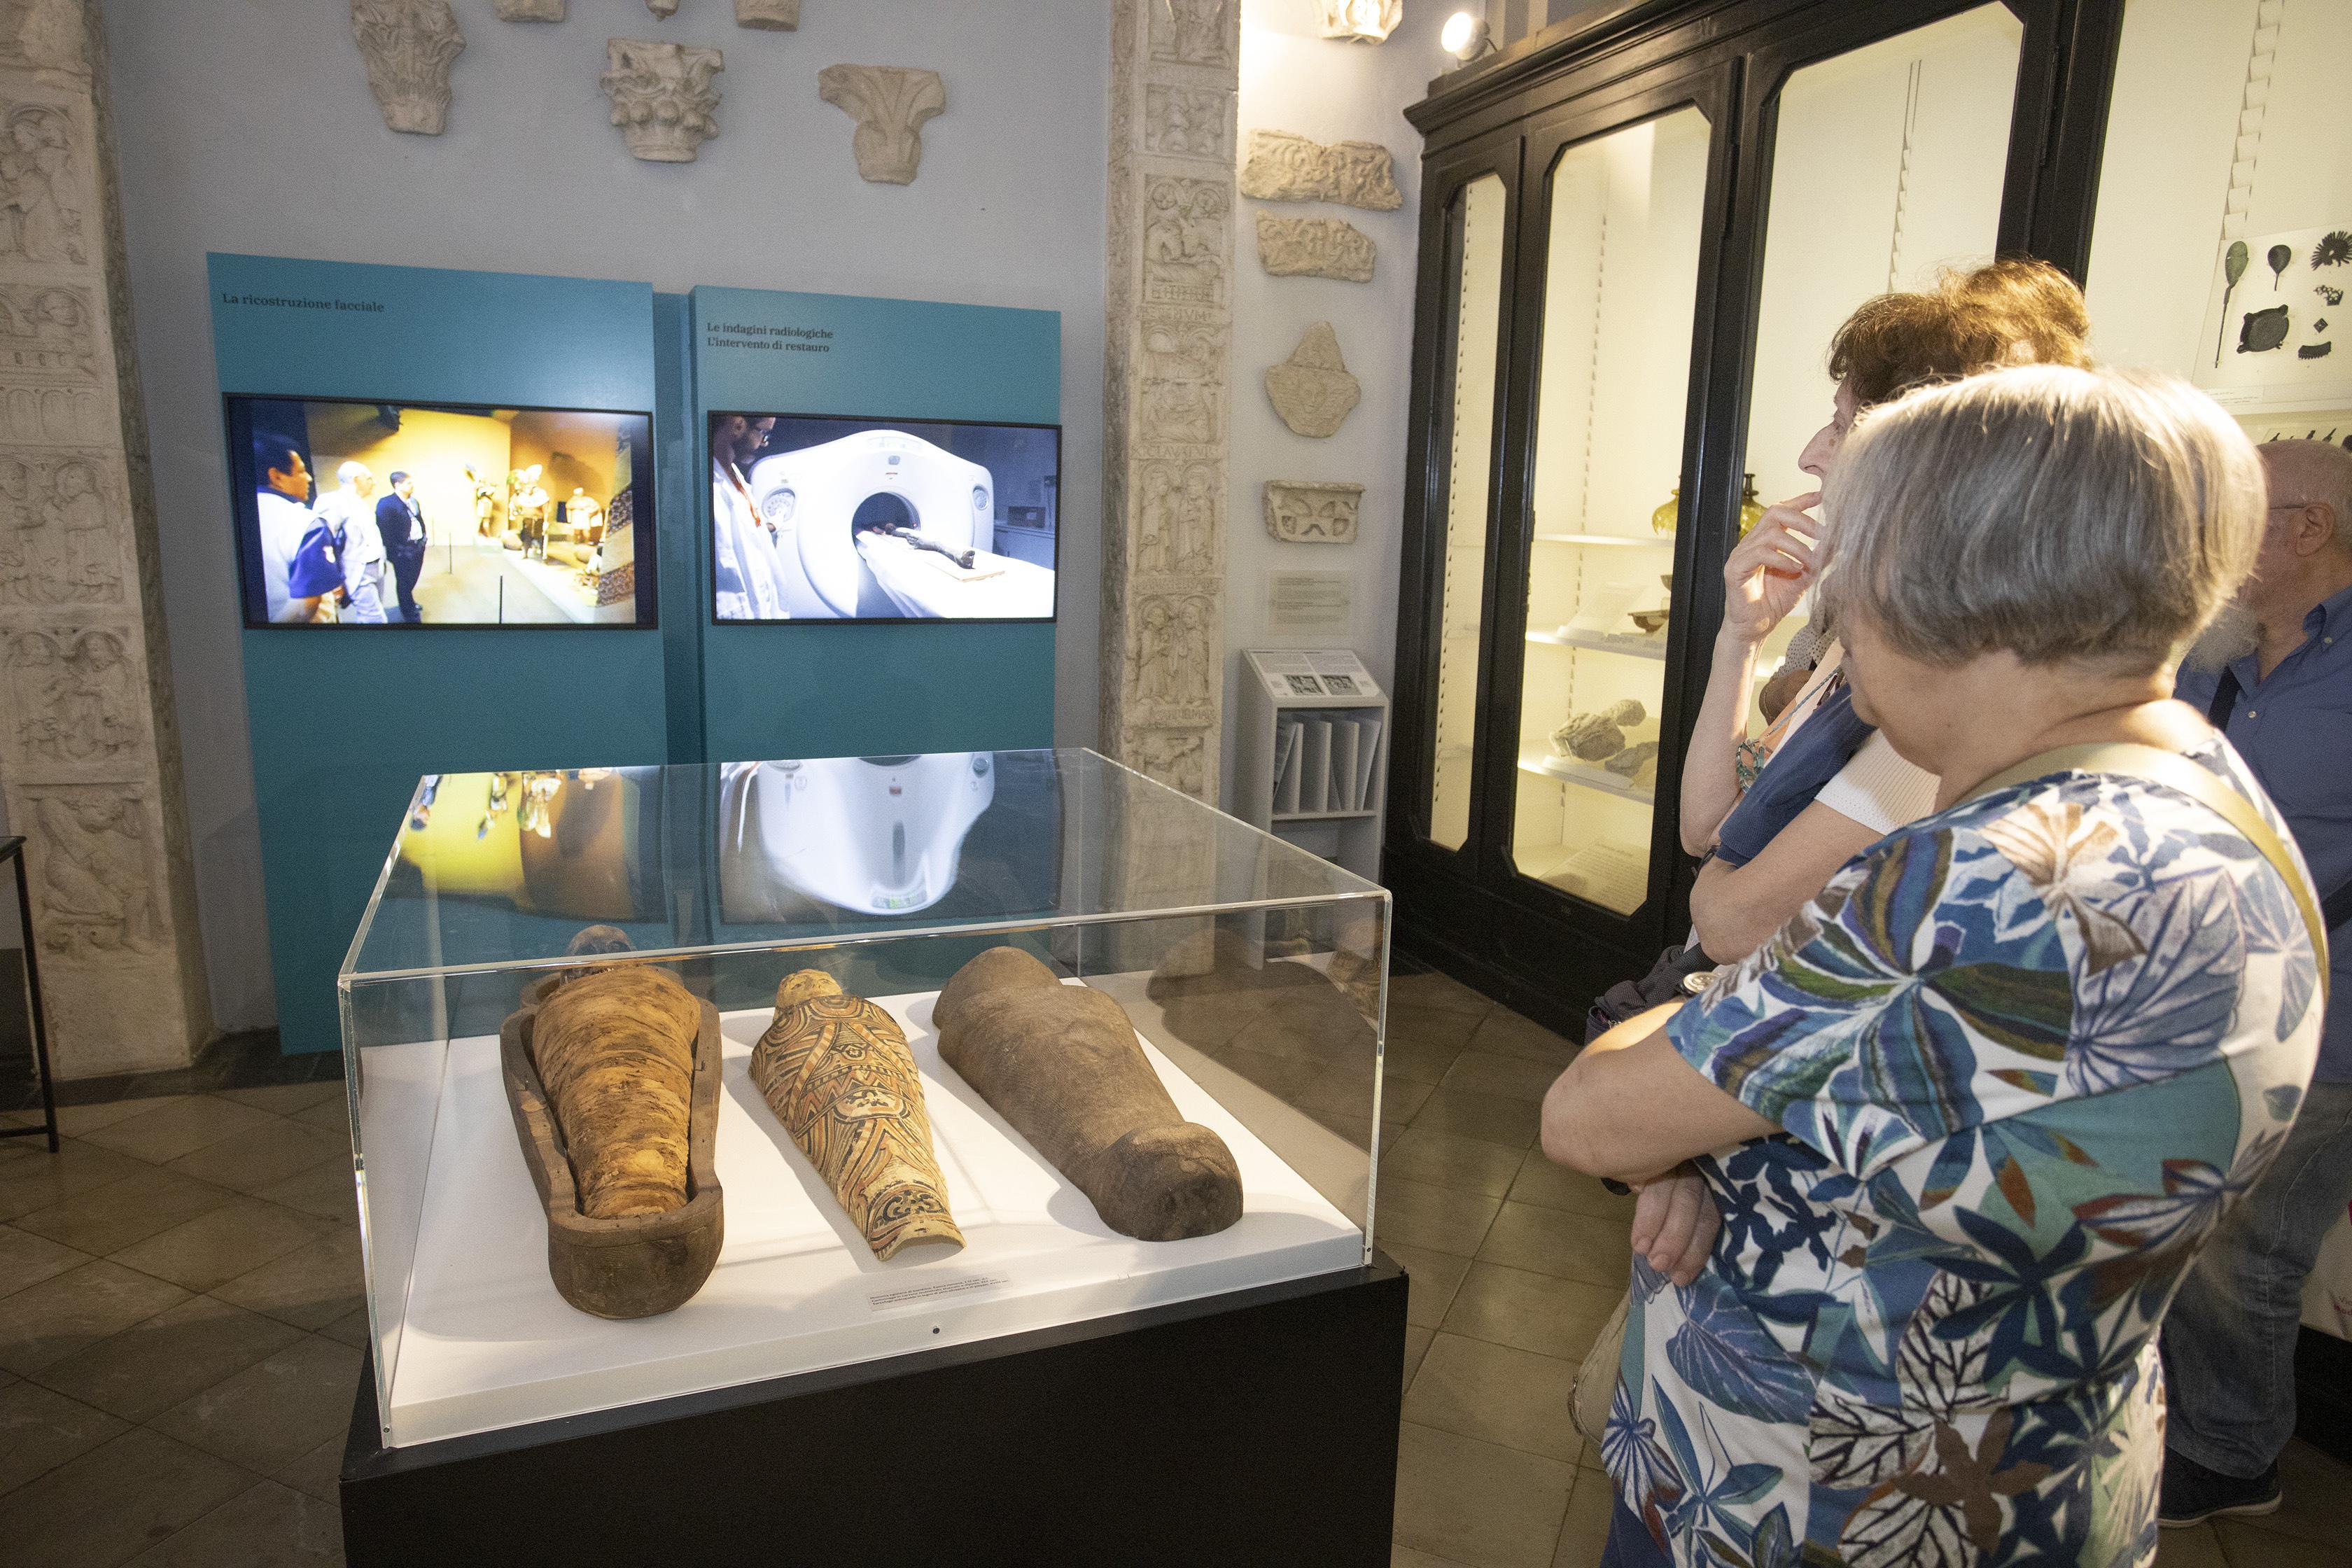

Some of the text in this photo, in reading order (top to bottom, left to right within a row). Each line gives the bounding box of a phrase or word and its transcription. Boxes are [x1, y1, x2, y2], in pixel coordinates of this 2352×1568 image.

[222, 293, 384, 312] La ricostruzione facciale
[707, 323, 833, 340] Le indagini radiologiche
[772, 340, 783, 350] di
[785, 342, 830, 352] restauro
